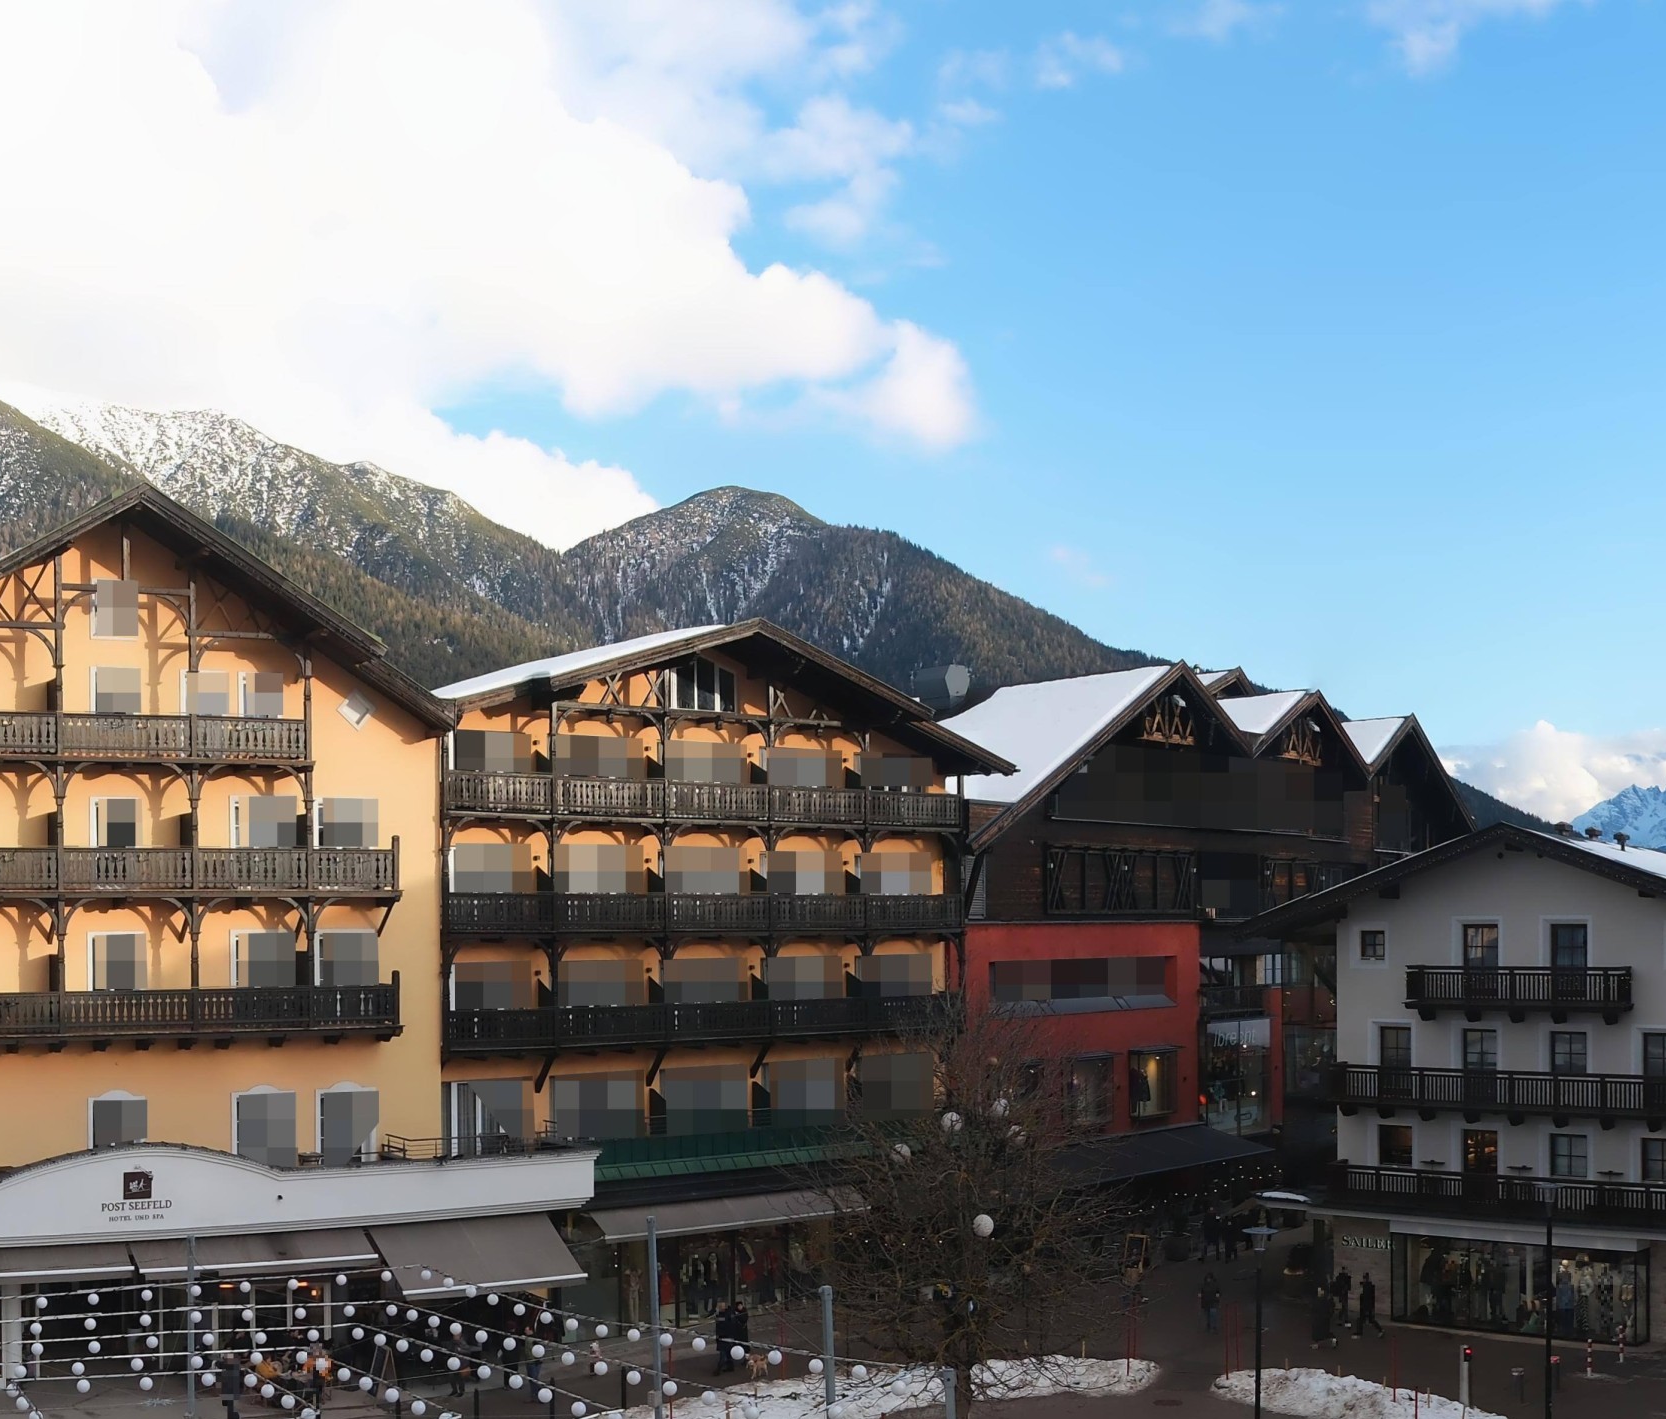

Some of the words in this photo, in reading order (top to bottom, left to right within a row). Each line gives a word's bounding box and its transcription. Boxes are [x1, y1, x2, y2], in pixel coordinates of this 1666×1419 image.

[101, 1202, 126, 1212] POST
[128, 1200, 172, 1211] SEEFELD
[1341, 1234, 1395, 1250] SAILER
